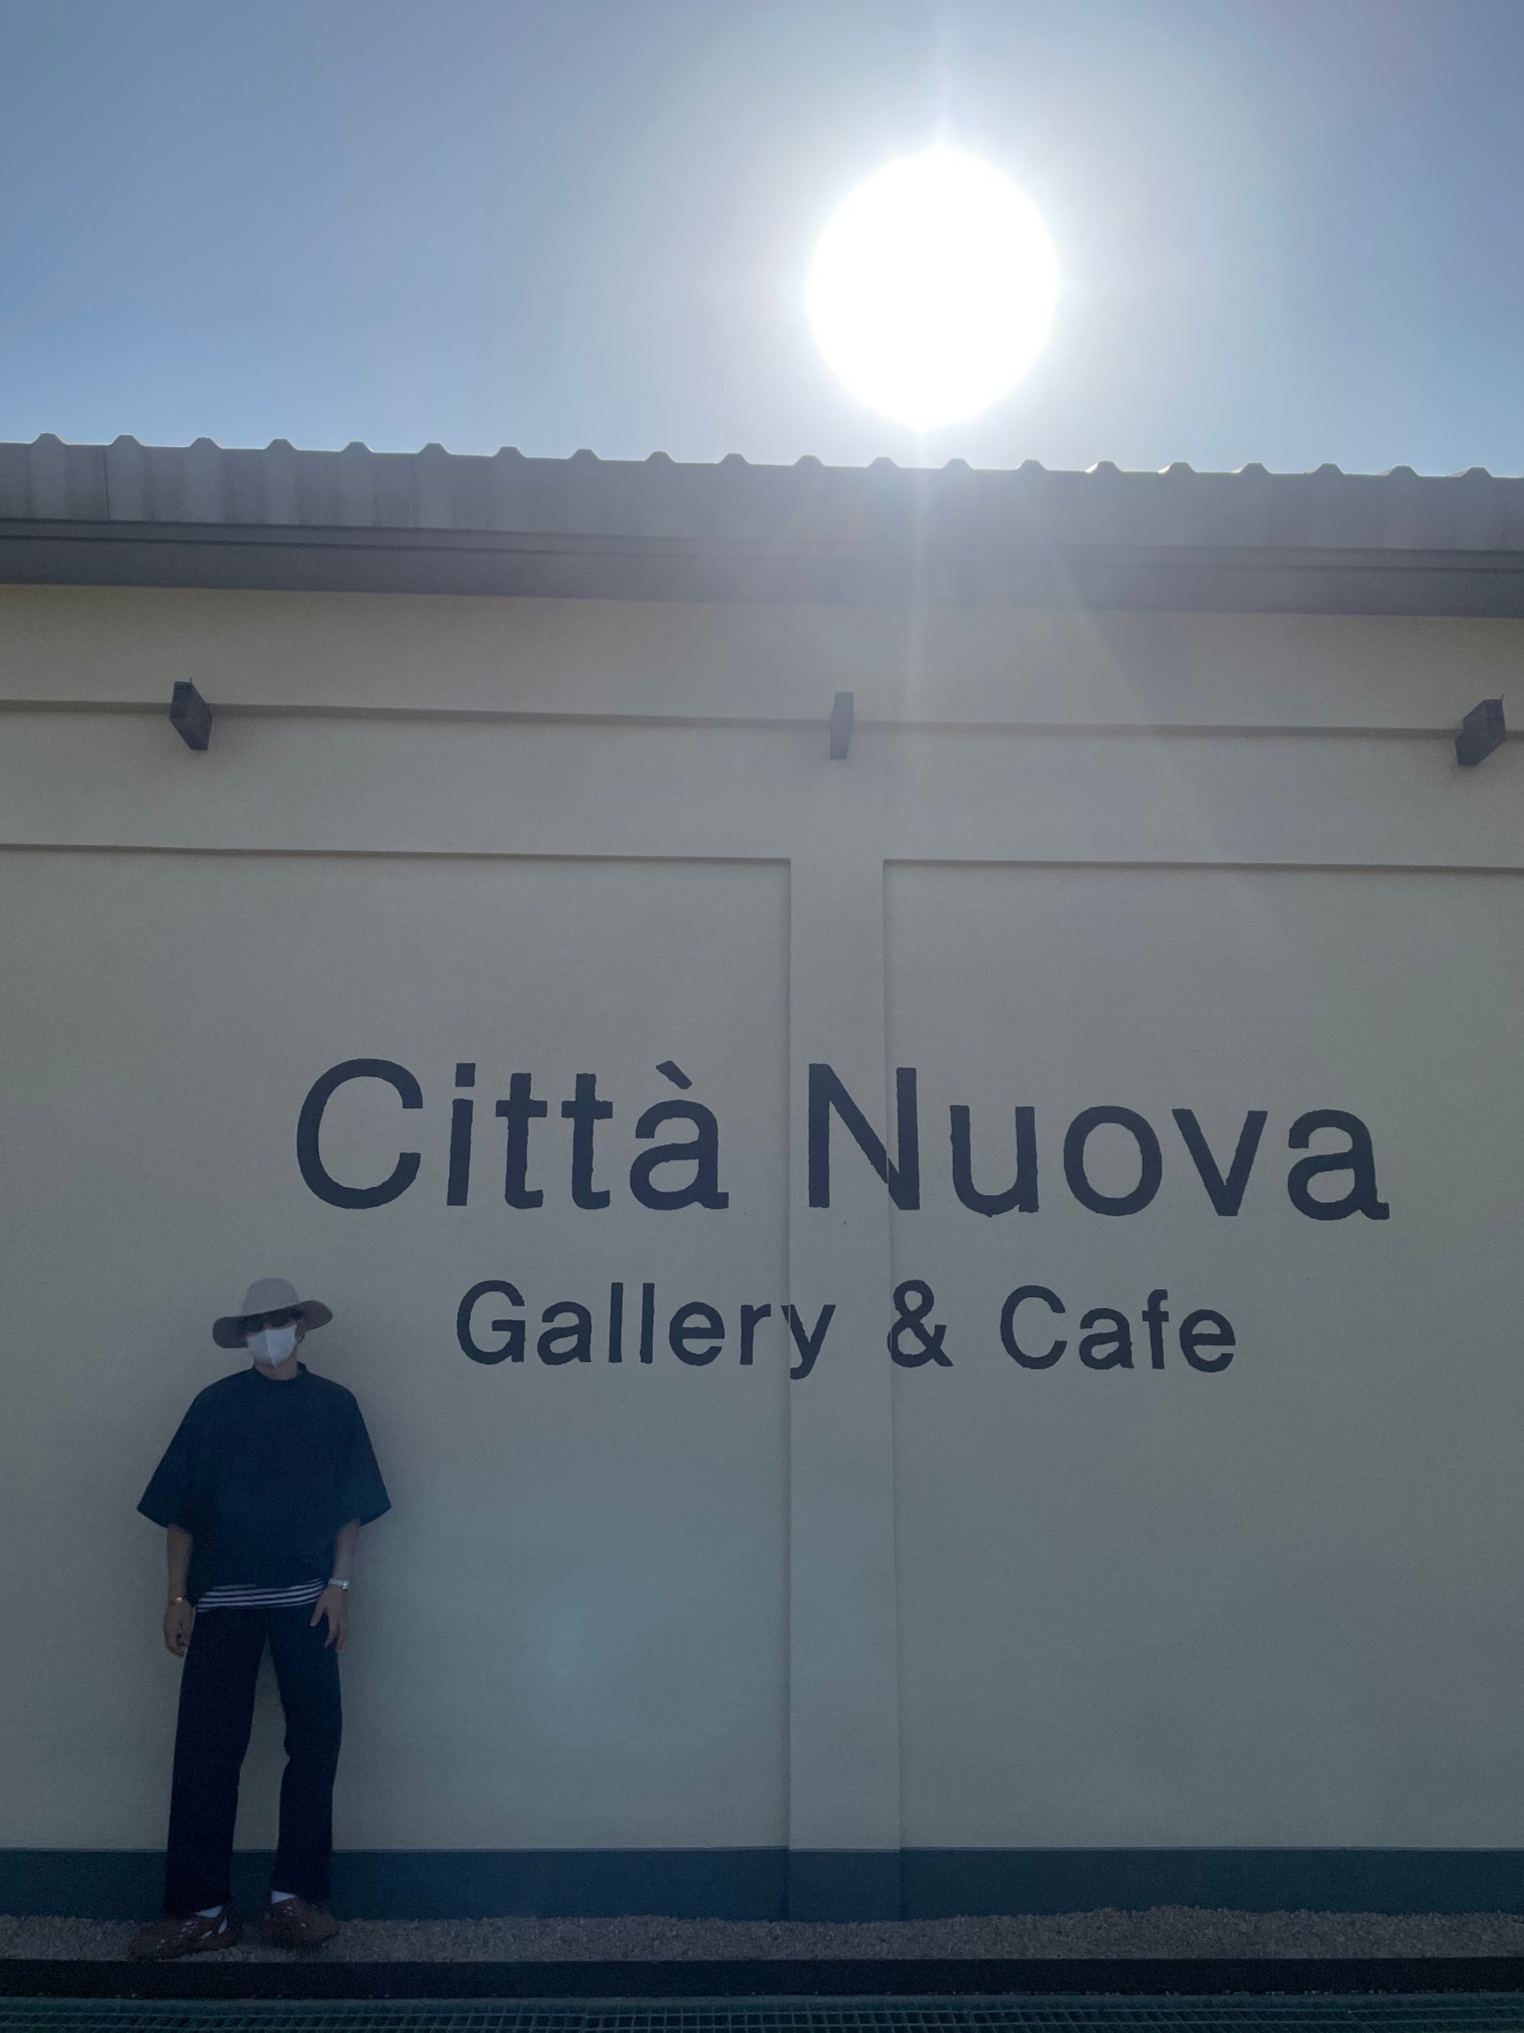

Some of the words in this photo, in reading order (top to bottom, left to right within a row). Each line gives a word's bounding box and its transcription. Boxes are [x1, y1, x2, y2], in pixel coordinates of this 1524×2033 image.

[297, 1058, 730, 1211] Città
[808, 1063, 1390, 1221] Nuova
[457, 1279, 837, 1381] Gallery
[887, 1279, 954, 1369] &
[1000, 1284, 1236, 1373] Cafe
